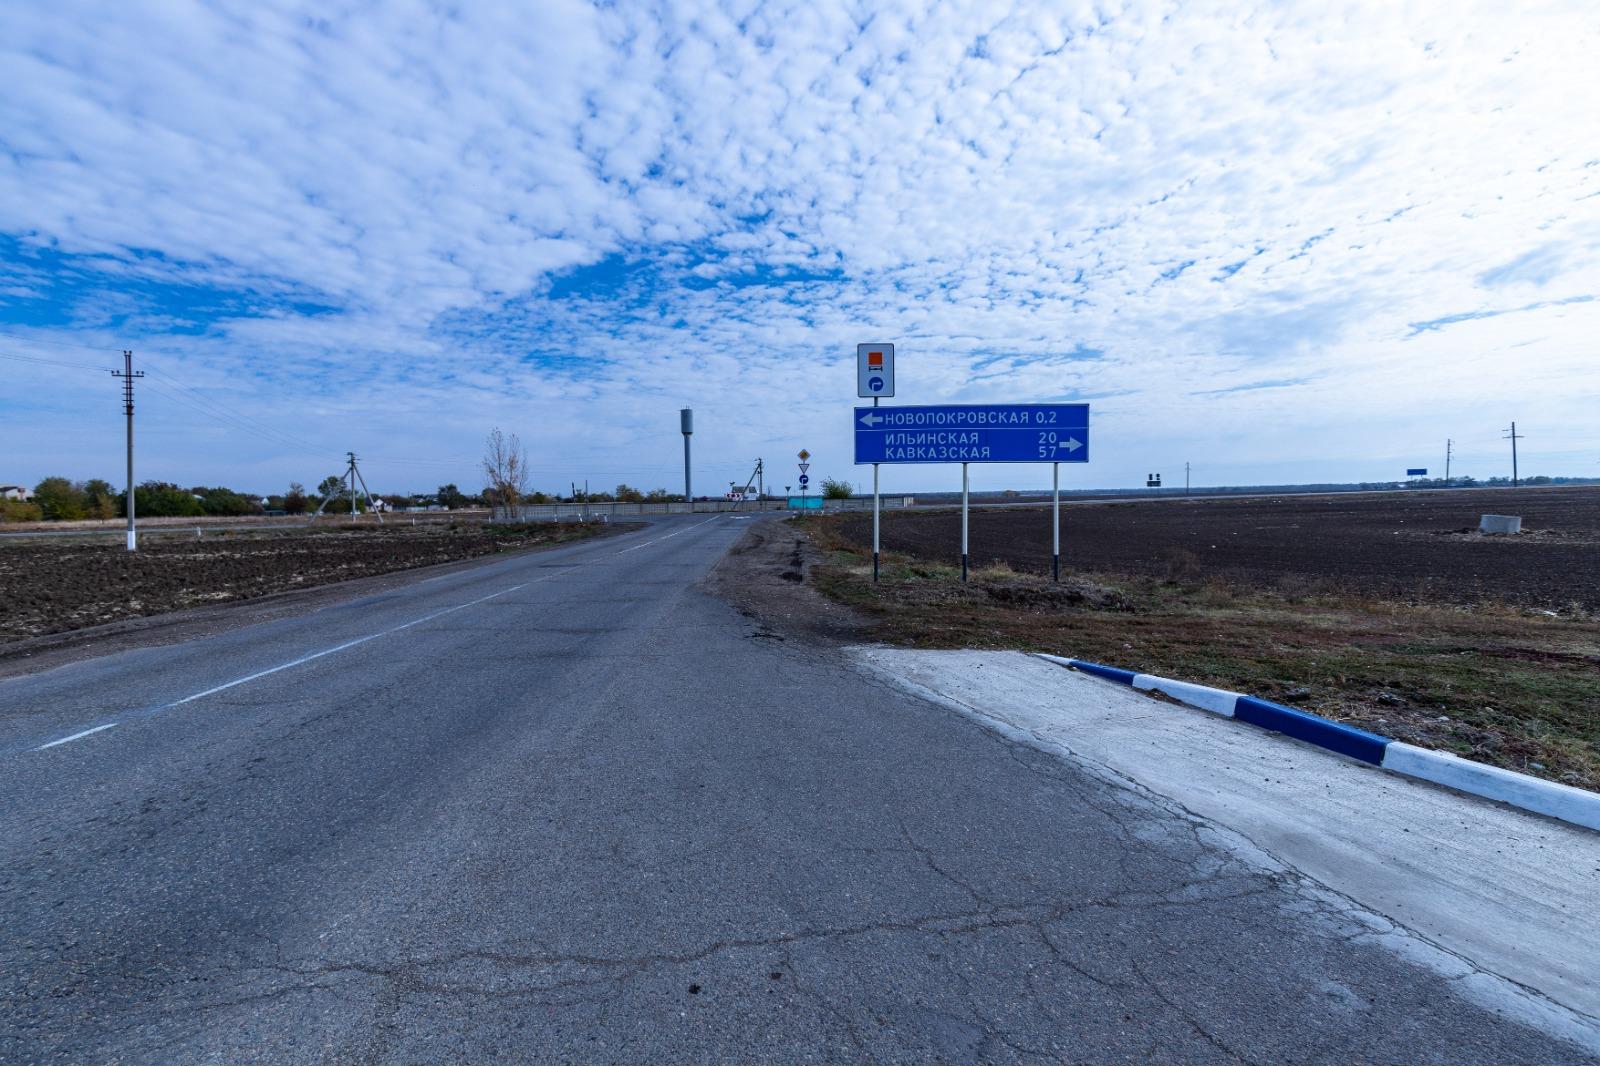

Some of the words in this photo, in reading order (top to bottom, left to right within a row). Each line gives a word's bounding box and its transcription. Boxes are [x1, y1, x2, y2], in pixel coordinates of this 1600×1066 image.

[885, 411, 1029, 424] НОВОПОКРОВСКАЯ
[885, 432, 979, 445] ИЛЬИНСКАЯ
[1039, 432, 1057, 444] 20
[885, 446, 990, 459] КАВКАЗСКАЯ
[1039, 446, 1057, 458] 57
